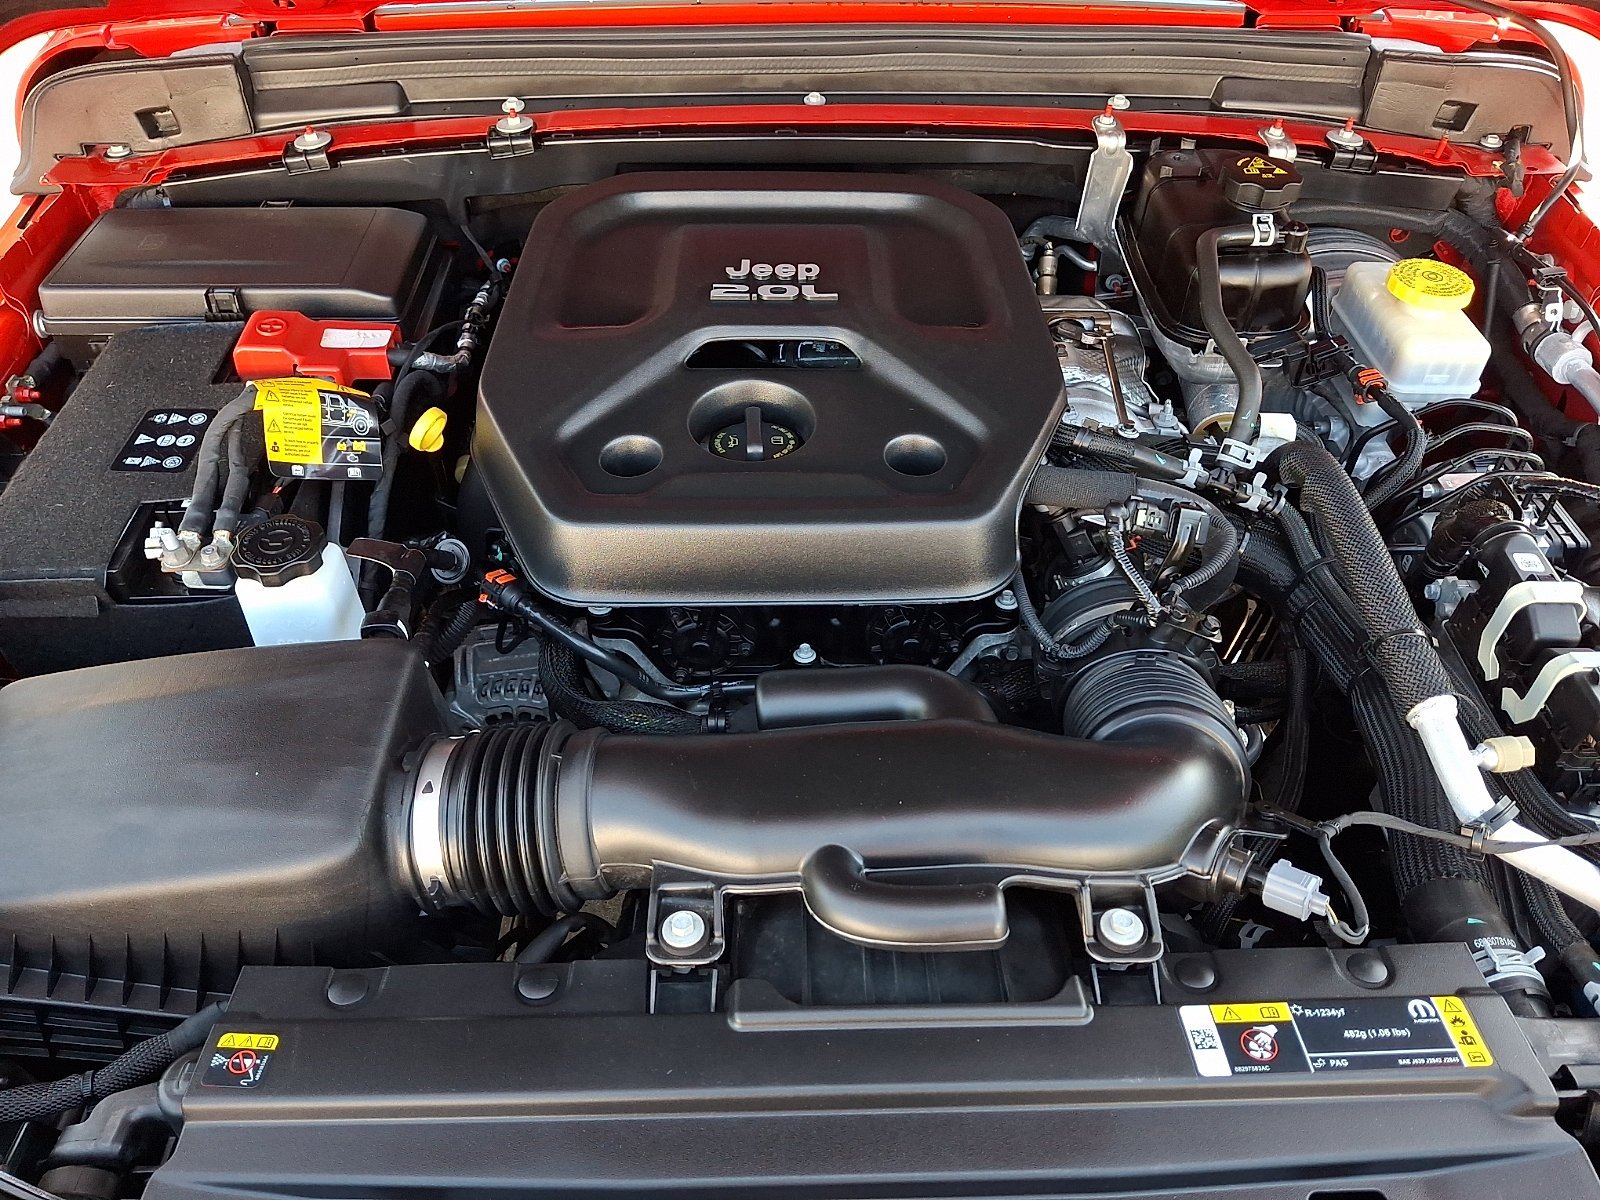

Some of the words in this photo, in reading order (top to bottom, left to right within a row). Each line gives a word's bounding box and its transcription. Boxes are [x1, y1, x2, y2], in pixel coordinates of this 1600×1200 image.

[725, 259, 820, 283] Jeep
[710, 283, 839, 301] 2.0L
[1304, 1007, 1345, 1018] R-1234yf
[1343, 1029, 1367, 1040] 482g
[1392, 1027, 1411, 1038] lbs)
[1329, 1058, 1349, 1068] PAG
